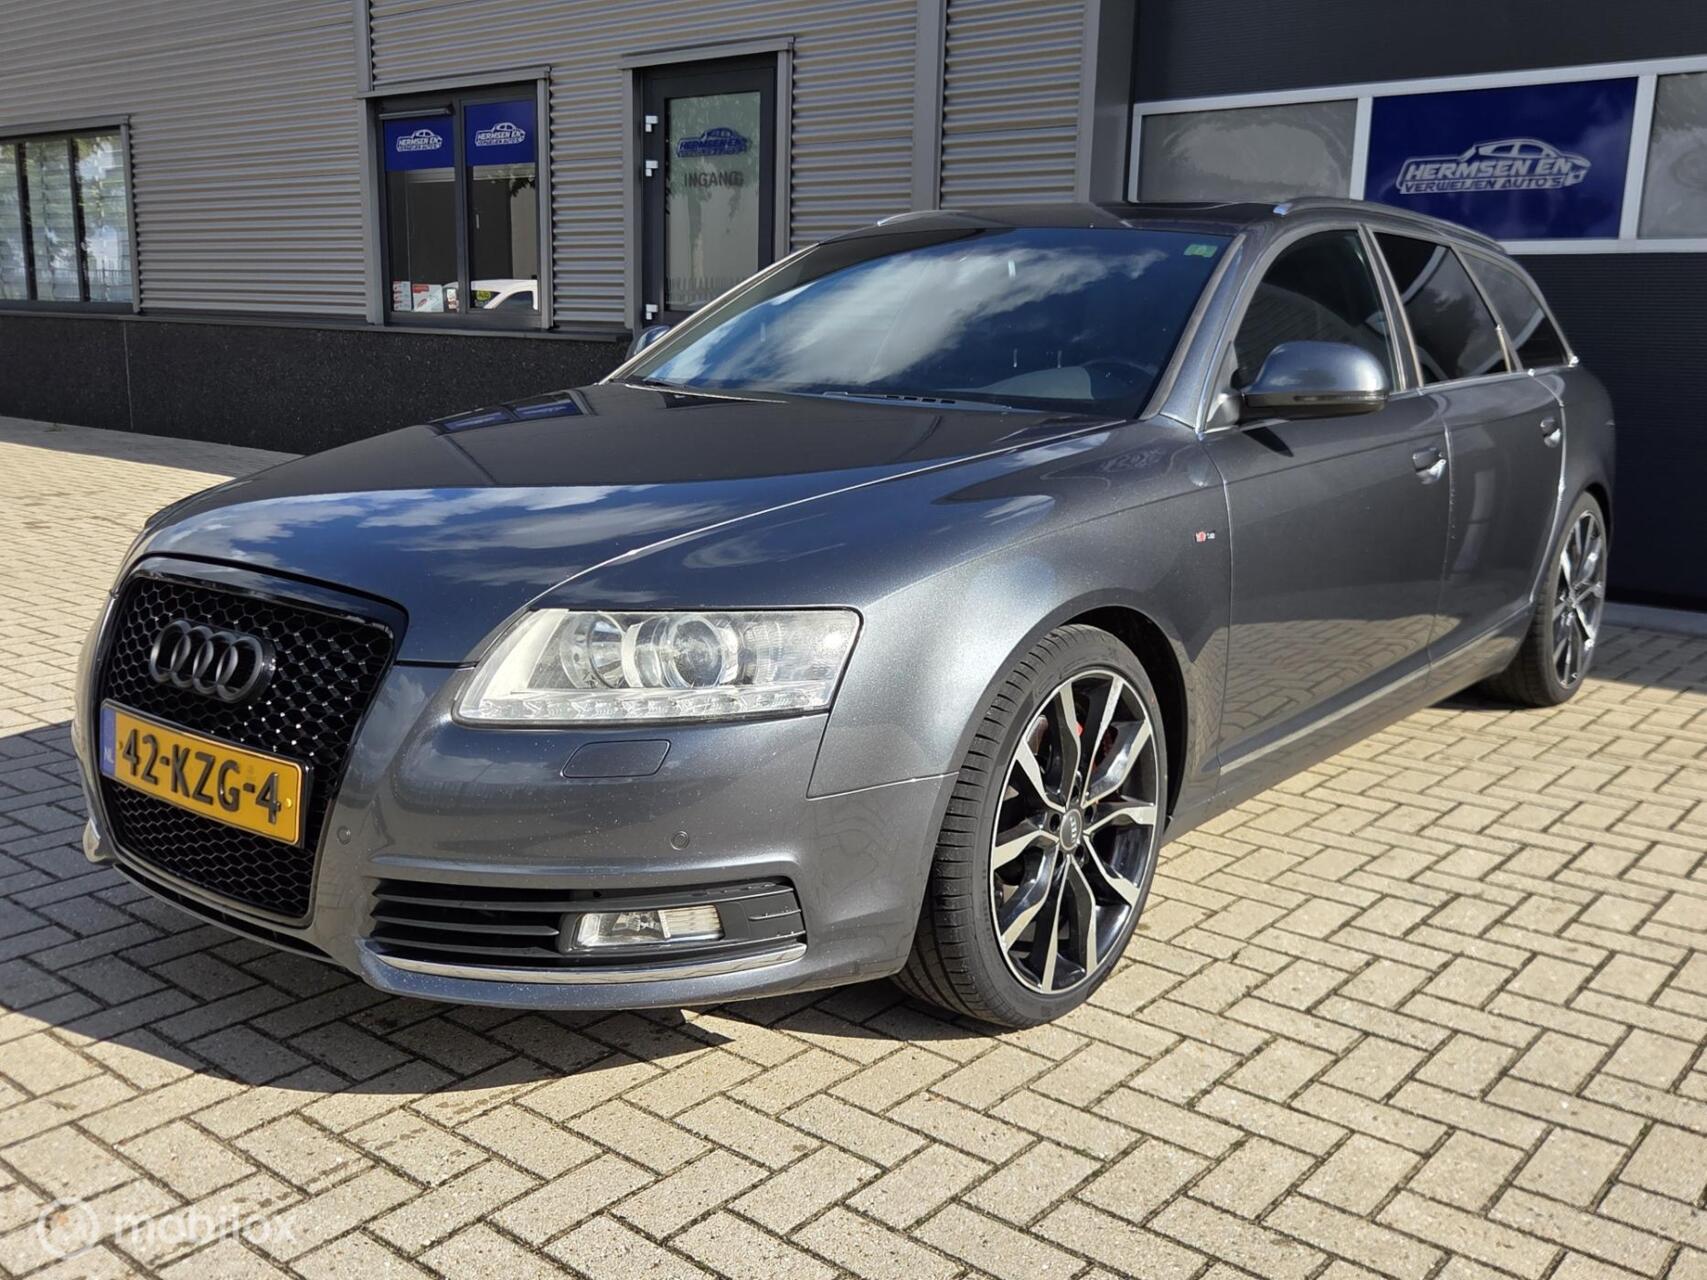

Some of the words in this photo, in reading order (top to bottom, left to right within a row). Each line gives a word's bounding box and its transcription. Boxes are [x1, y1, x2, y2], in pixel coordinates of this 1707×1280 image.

[684, 170, 744, 188] INGANG
[1407, 160, 1531, 180] HERMSEN
[1537, 158, 1571, 175] EN
[122, 729, 282, 825] 42-KZG-4
